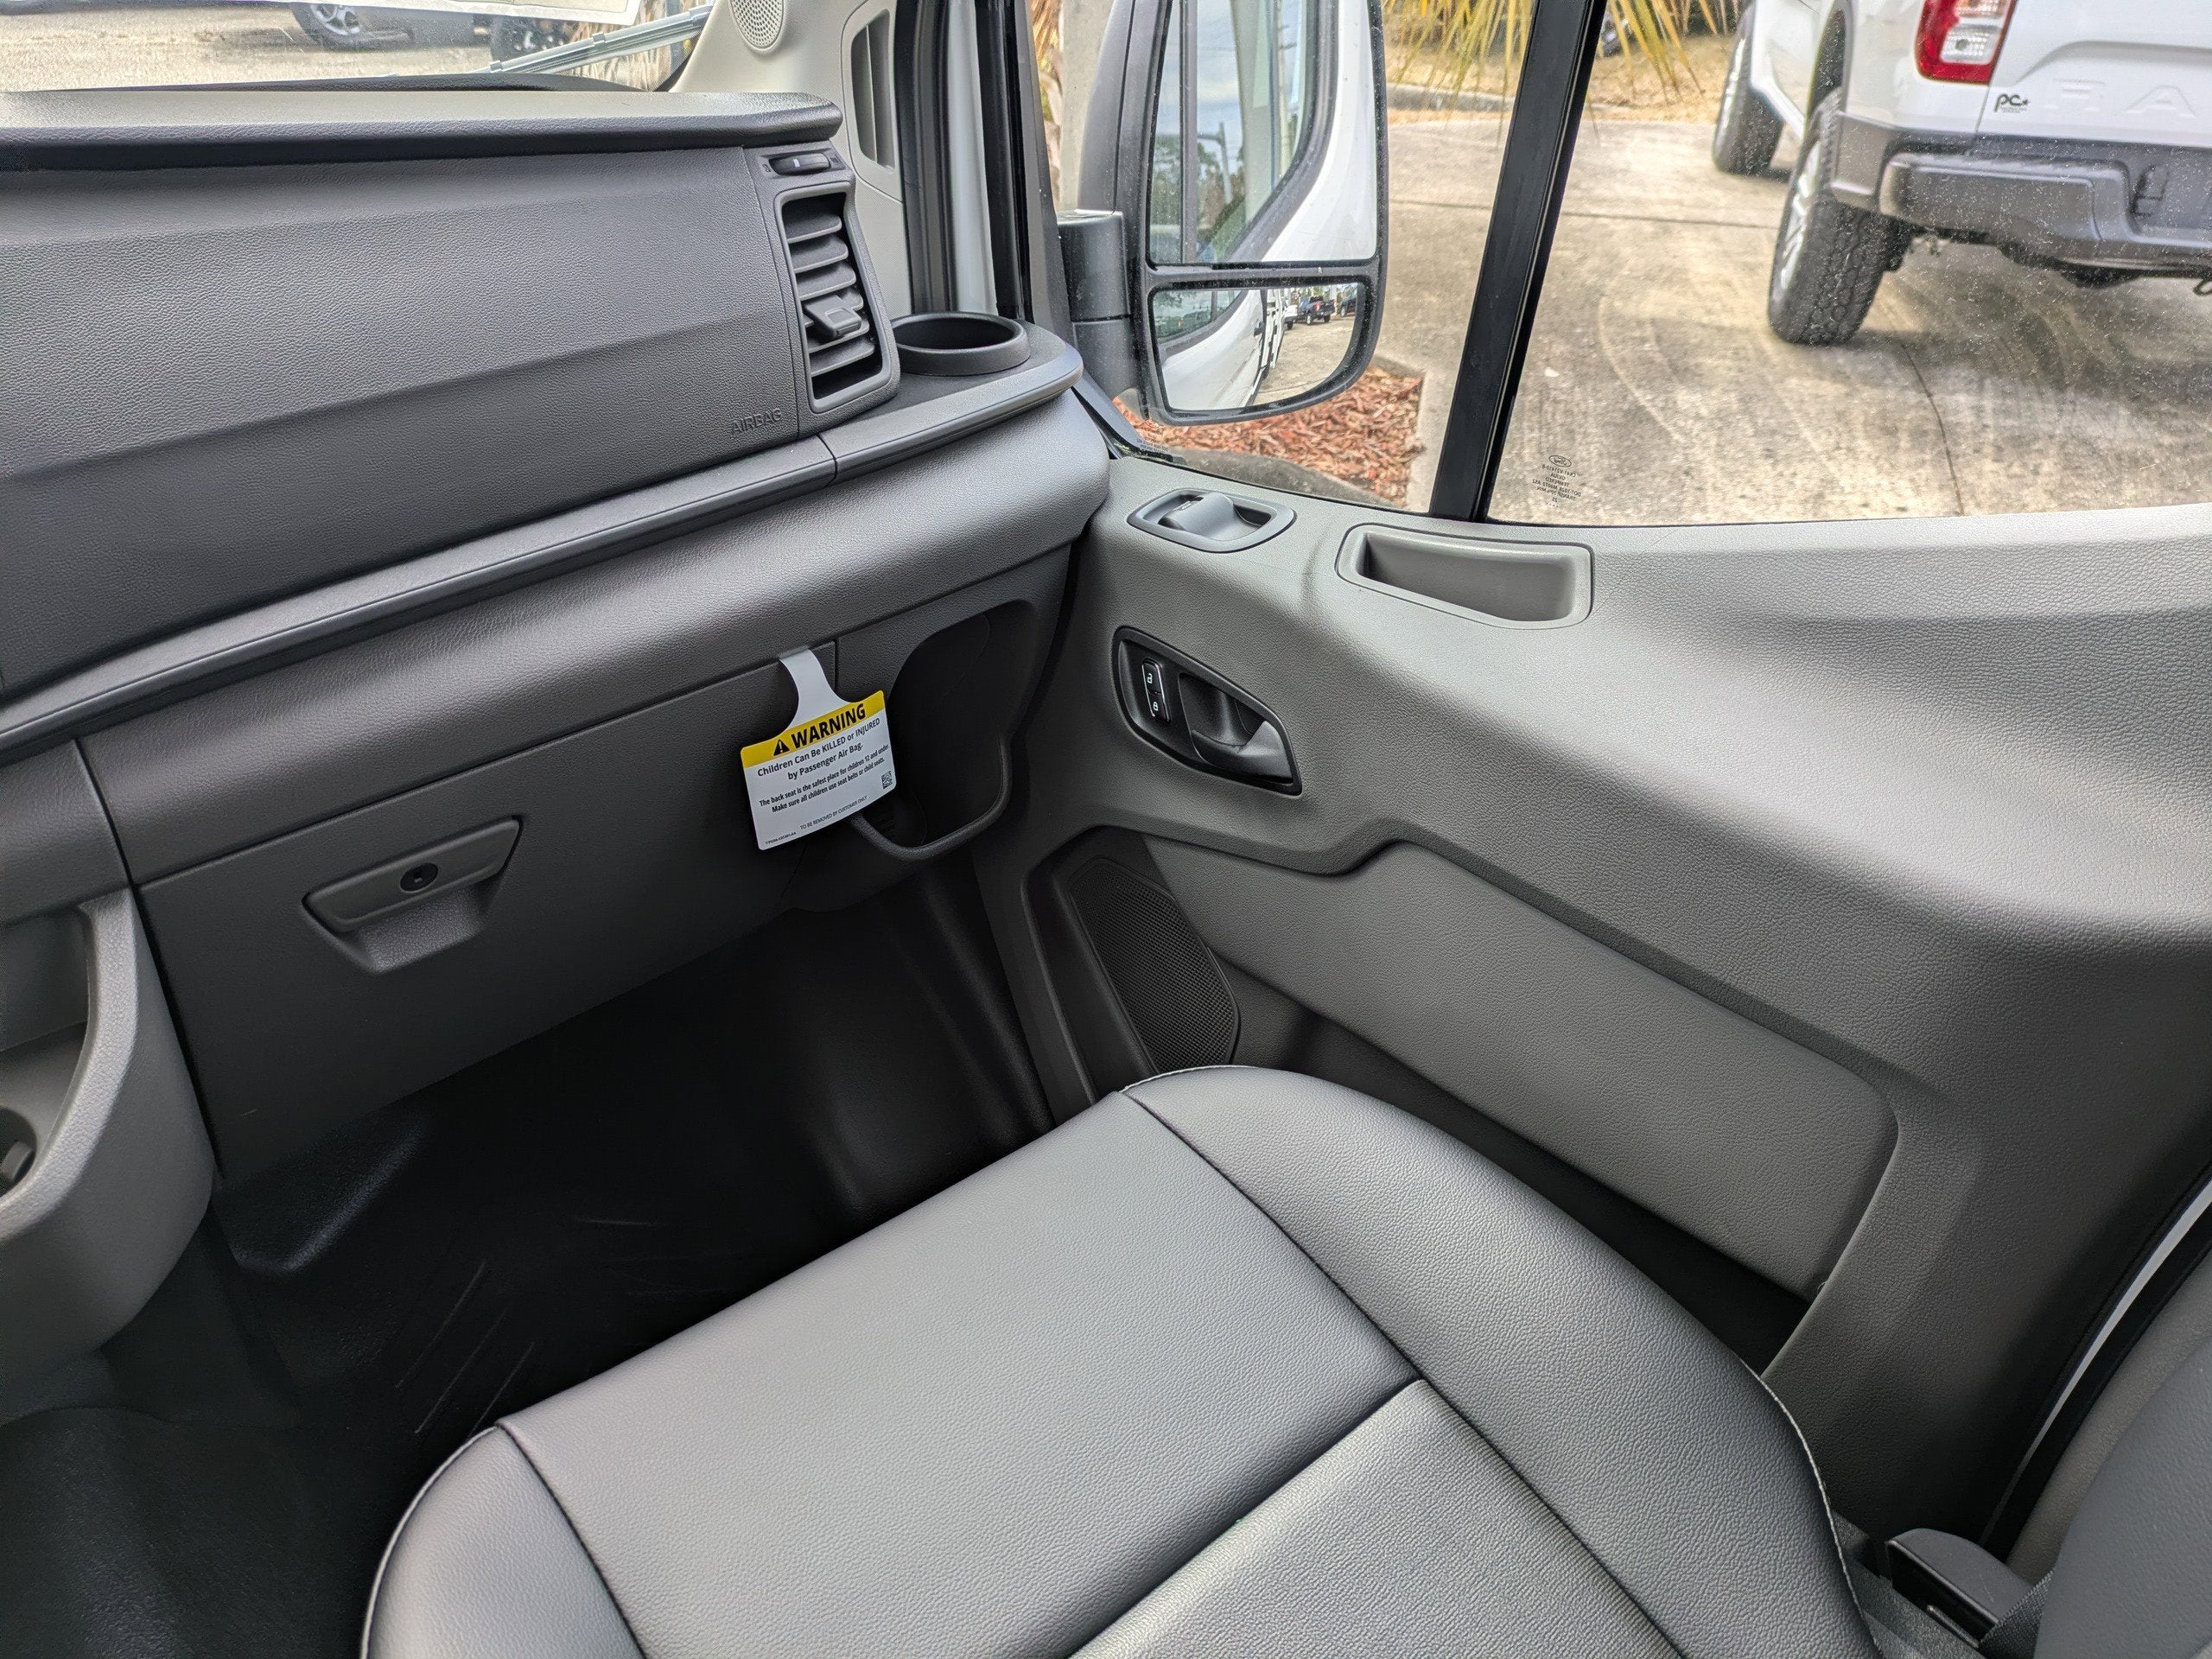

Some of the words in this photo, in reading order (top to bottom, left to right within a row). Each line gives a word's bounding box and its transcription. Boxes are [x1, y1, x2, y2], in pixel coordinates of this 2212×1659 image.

[732, 407, 782, 433] AIRBAG
[757, 760, 793, 776] Children
[795, 753, 810, 764] Can
[810, 748, 821, 758] Be
[822, 736, 846, 753] KILLED
[847, 733, 855, 741] or
[855, 717, 880, 737] INJURED
[791, 703, 866, 749] WARNING
[771, 793, 784, 804] back
[785, 789, 797, 798] seat
[811, 777, 827, 788] safest
[826, 771, 840, 783] place
[847, 759, 865, 772] children
[787, 771, 798, 780] by
[799, 753, 836, 776] Passenger
[838, 748, 849, 760] Air
[849, 742, 863, 753] Bag.
[772, 803, 787, 813] Make
[788, 798, 800, 807] sure
[808, 786, 829, 799] children
[837, 778, 848, 786] seat
[847, 772, 859, 782] belts
[864, 762, 874, 772] child
[812, 813, 832, 825] REMOVED
[837, 800, 858, 814] CUSTOMER
[857, 795, 868, 804] ONLY
